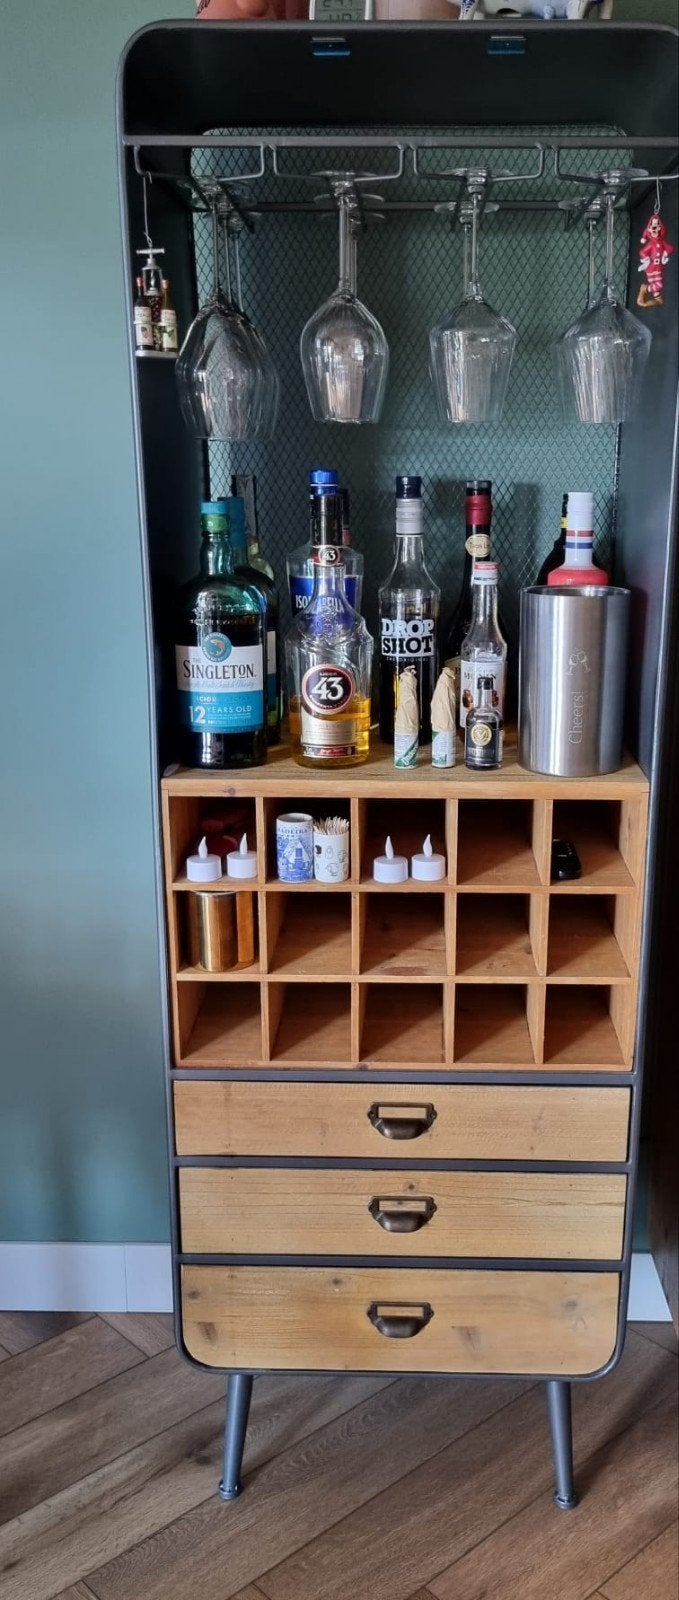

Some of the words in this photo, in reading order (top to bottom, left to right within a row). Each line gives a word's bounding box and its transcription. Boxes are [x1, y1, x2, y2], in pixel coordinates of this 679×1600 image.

[323, 550, 336, 561] 43
[381, 618, 435, 637] DROP
[382, 636, 433, 655] SHOT
[311, 676, 344, 701] 43
[189, 705, 206, 724] 12
[207, 705, 233, 714] YEARS
[567, 691, 584, 744] Cheers!
